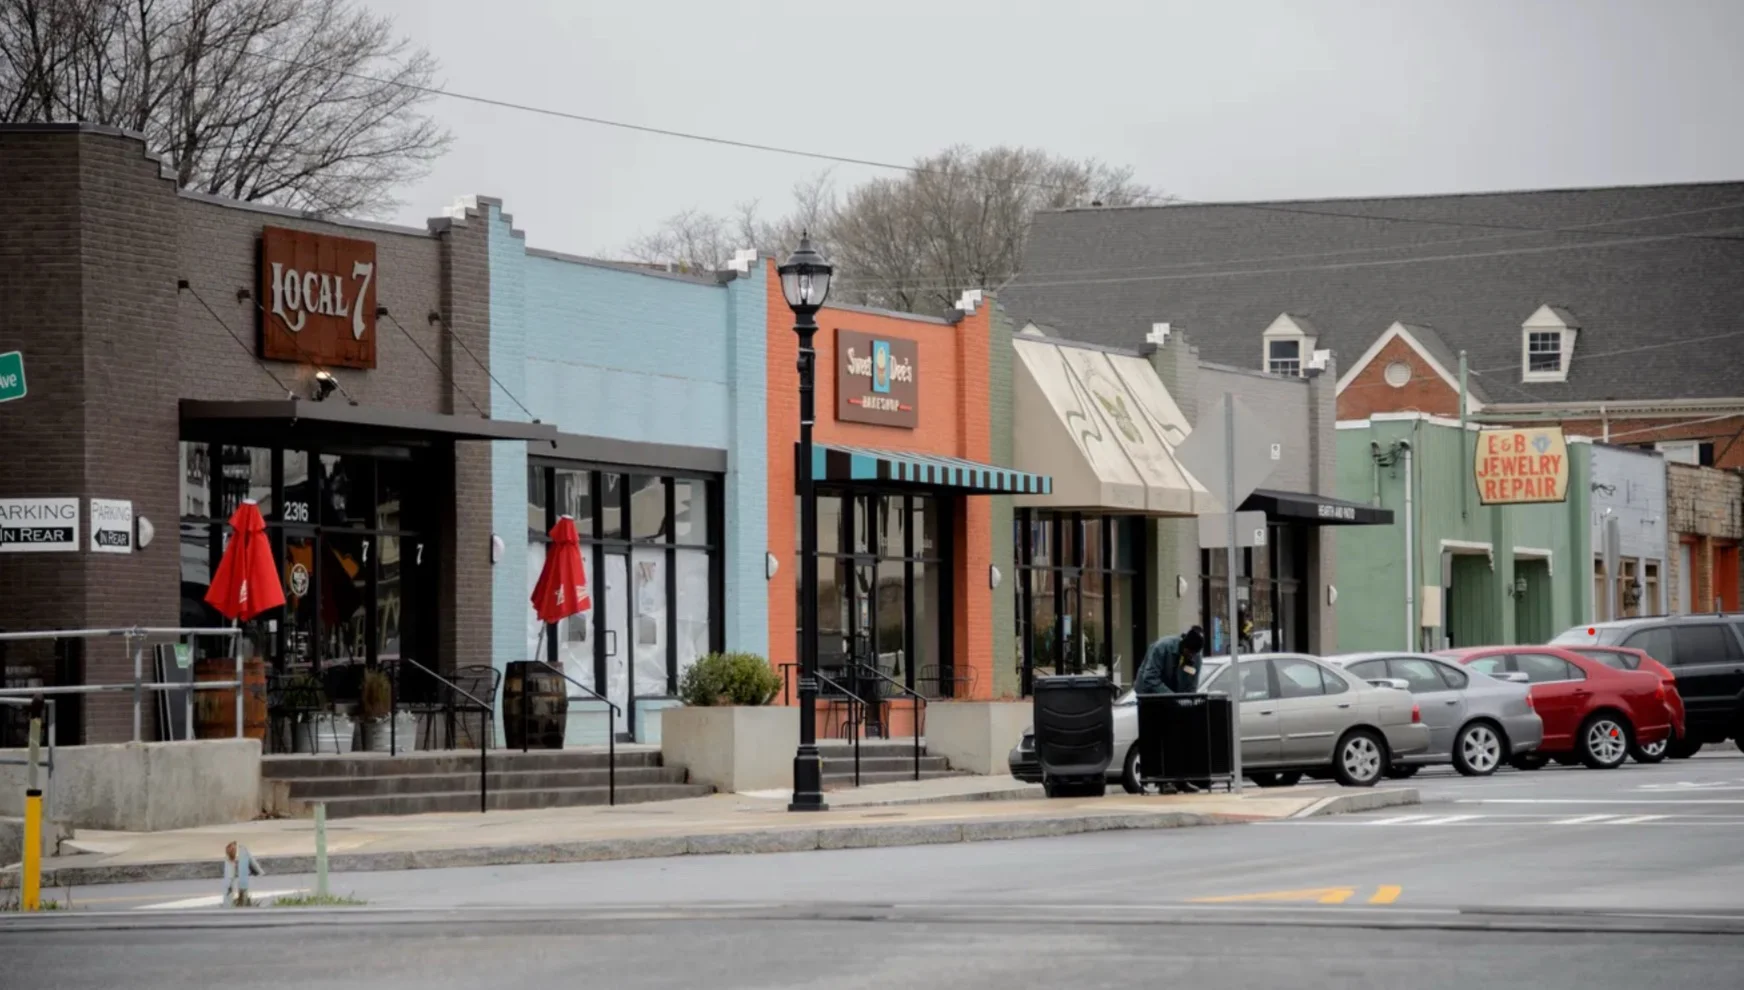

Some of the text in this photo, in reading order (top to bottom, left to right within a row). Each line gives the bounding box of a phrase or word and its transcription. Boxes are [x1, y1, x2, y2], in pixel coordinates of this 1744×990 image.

[271, 260, 373, 340] LOCAL 7
[847, 347, 913, 383] Sweet Dee's
[862, 396, 899, 411] BAKESHOP
[1478, 455, 1562, 478] JEWELRY
[1485, 477, 1557, 500] REPAIR
[92, 501, 131, 522] PARKING
[284, 501, 309, 521] 2316
[20, 528, 64, 541] REAR
